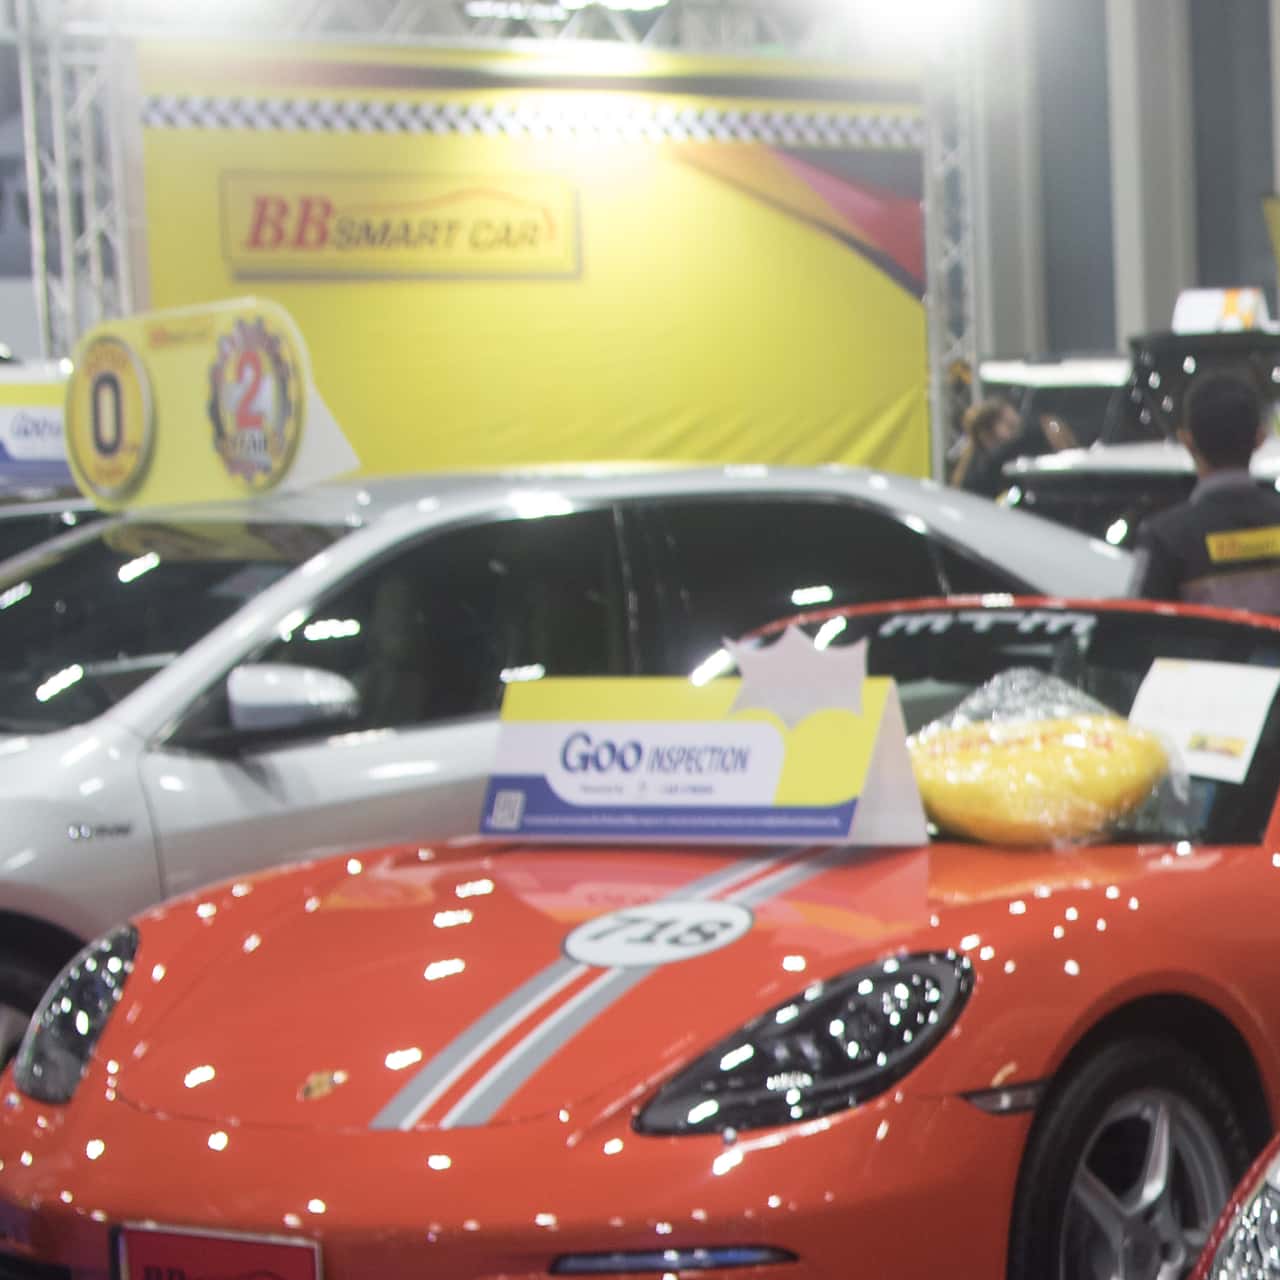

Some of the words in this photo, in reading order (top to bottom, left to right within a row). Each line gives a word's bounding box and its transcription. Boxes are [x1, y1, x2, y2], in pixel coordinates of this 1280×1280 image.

[467, 215, 543, 250] CAR
[90, 370, 125, 457] 0
[236, 349, 264, 431] 2
[560, 731, 643, 774] Goo
[648, 744, 751, 774] INSPECTION
[585, 916, 734, 946] 718
